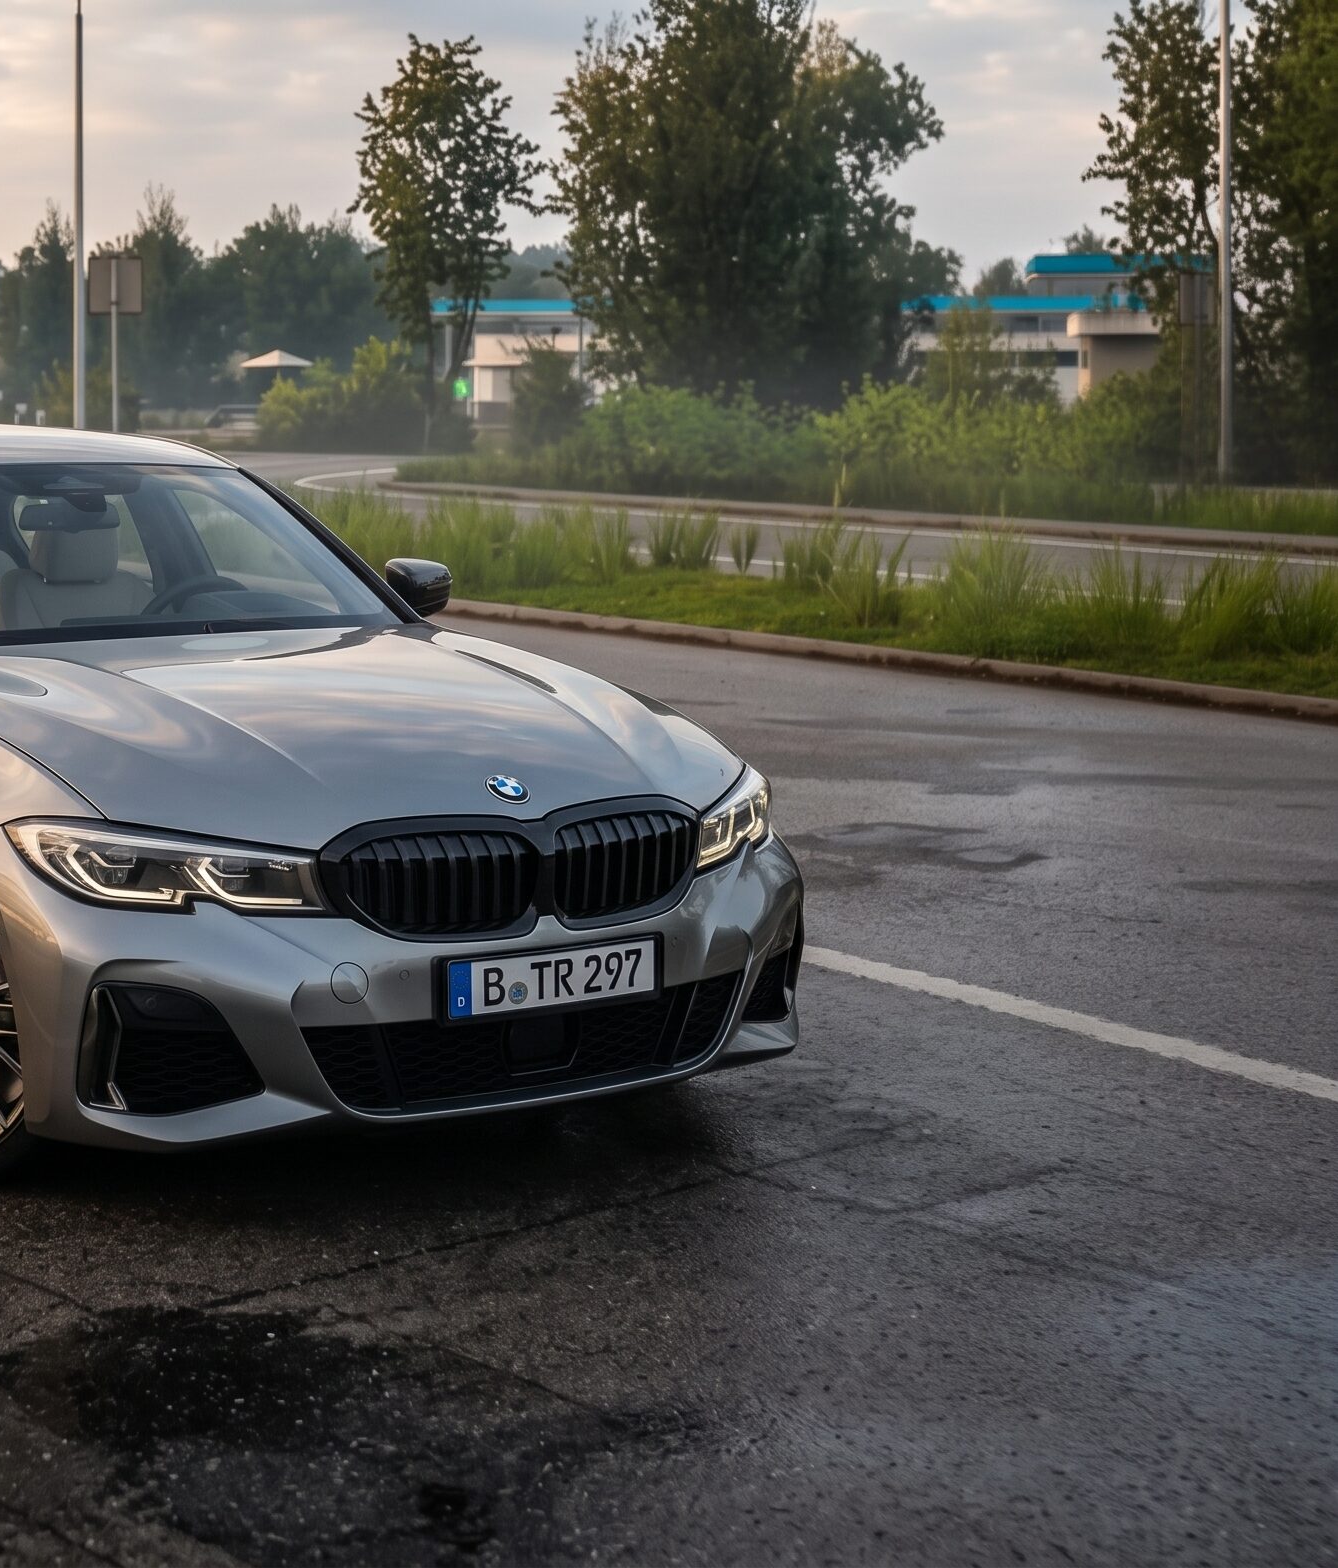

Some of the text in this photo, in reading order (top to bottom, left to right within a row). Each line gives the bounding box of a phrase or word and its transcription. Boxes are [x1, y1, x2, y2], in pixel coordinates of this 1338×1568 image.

[483, 948, 643, 1007] B TR 297
[457, 996, 465, 1008] D
